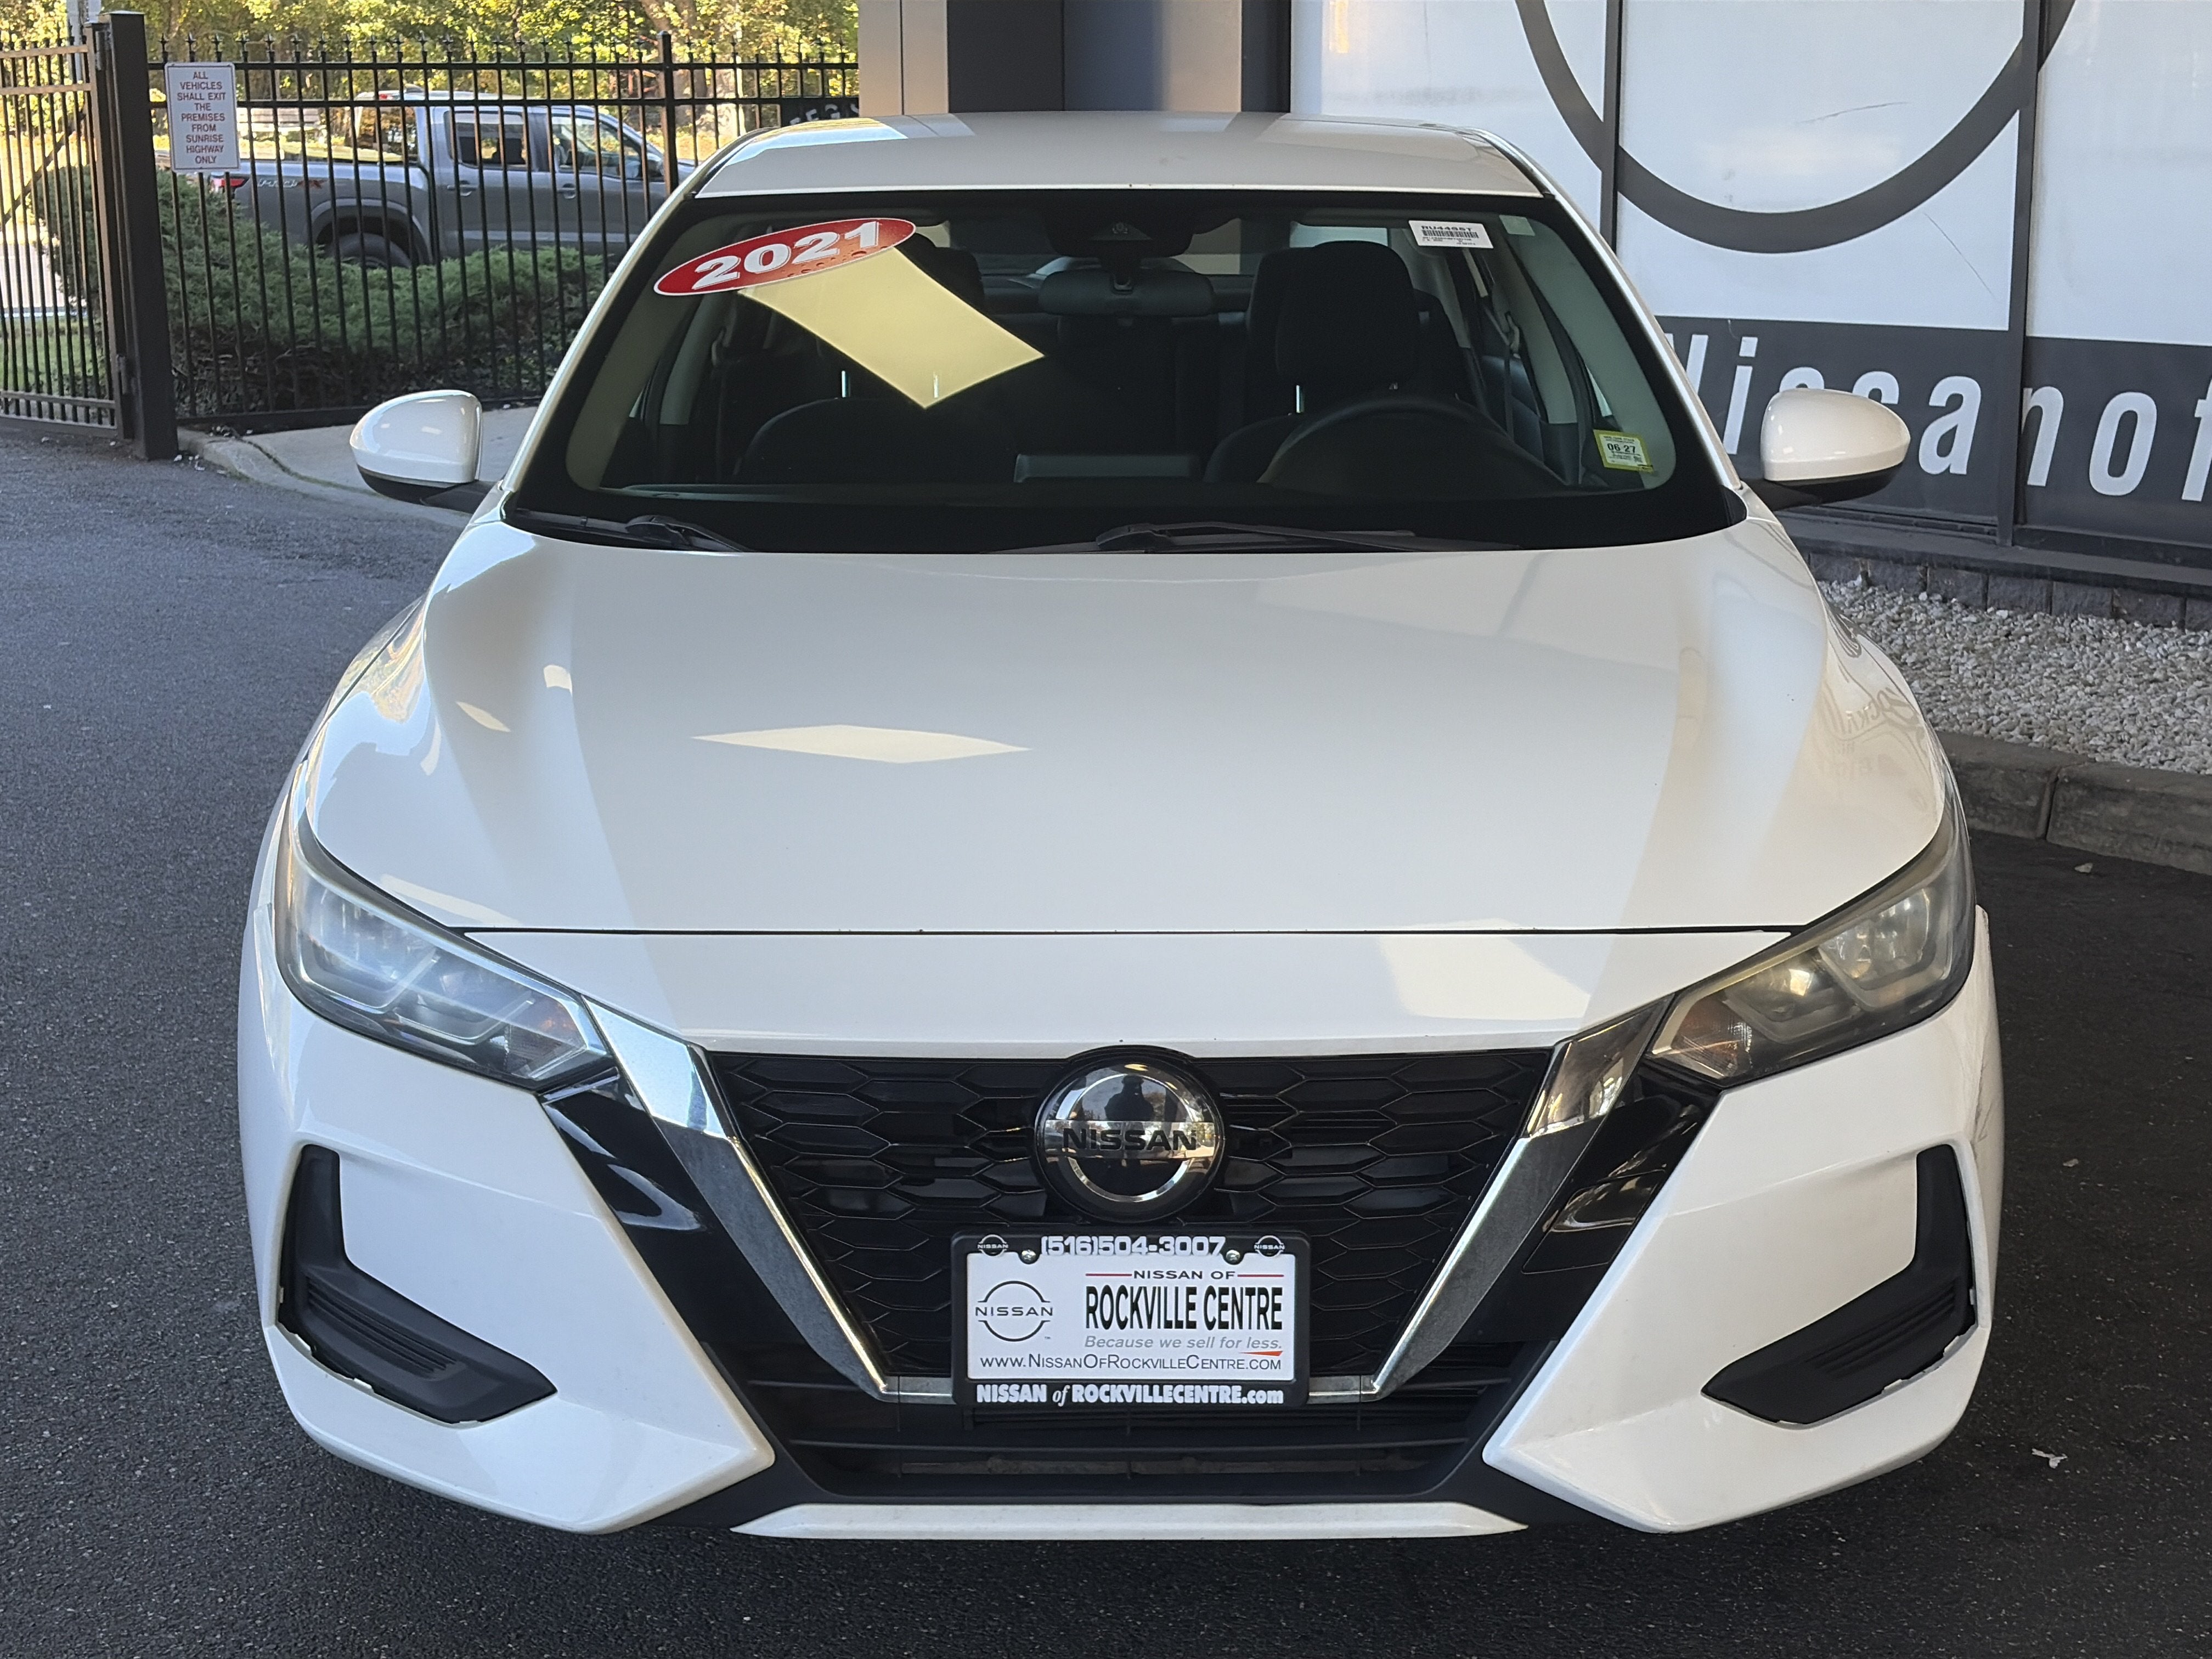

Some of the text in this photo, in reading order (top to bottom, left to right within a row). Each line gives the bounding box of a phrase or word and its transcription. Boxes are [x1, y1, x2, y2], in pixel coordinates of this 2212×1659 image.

[193, 71, 208, 80] ALL
[180, 82, 222, 90] VEHICLES
[181, 113, 225, 122] PREMISES
[191, 123, 216, 132] FROM
[186, 134, 224, 143] SUNRISE
[186, 145, 224, 153] HIGHWAY
[195, 156, 217, 164] ONLY
[691, 221, 880, 290] 2021
[1062, 1128, 1197, 1150] NISSAN
[1133, 1270, 1235, 1280] NISSAN OF
[975, 1307, 1053, 1317] NISSAN
[1085, 1285, 1283, 1331] ROCKVILLE CENTRE
[1085, 1336, 1282, 1350] Because we sell for less.
[977, 1384, 1284, 1407] NISSAN of ROCKVILLECENTRE.com
